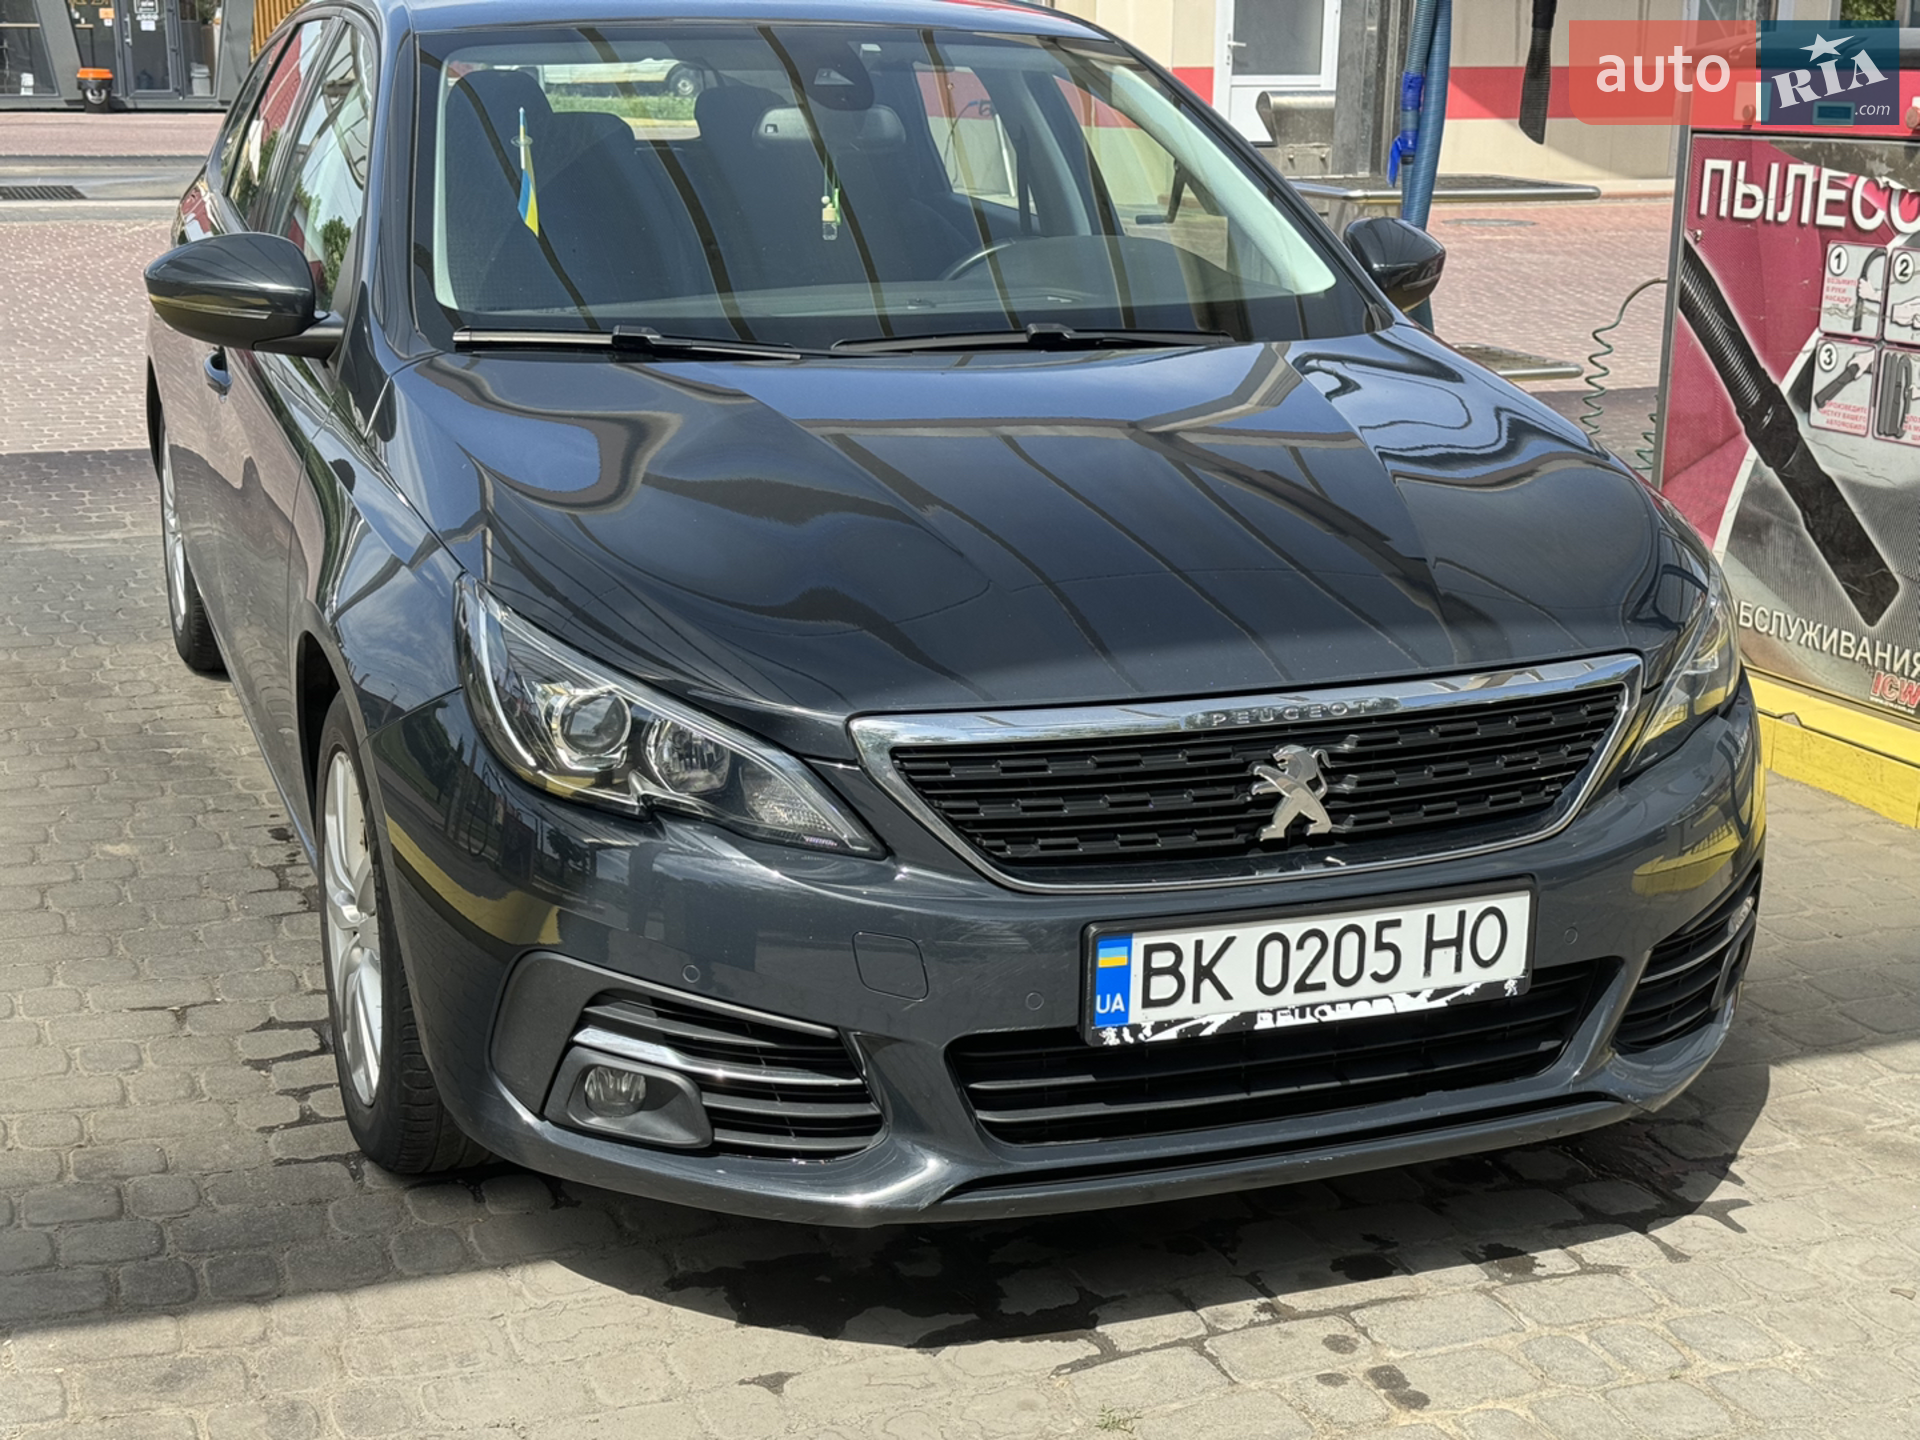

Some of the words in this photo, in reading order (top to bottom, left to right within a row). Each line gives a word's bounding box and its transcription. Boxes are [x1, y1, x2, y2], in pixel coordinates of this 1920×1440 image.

[1834, 251, 1842, 270] 1
[1898, 258, 1909, 277] 2
[1823, 348, 1833, 366] 3
[1733, 599, 1920, 679] БСЛУЖИВАНИЯ
[1212, 701, 1370, 726] PEUGEOT
[1141, 935, 1237, 1010] BK
[1255, 918, 1403, 997] 0205
[1096, 993, 1125, 1014] UA
